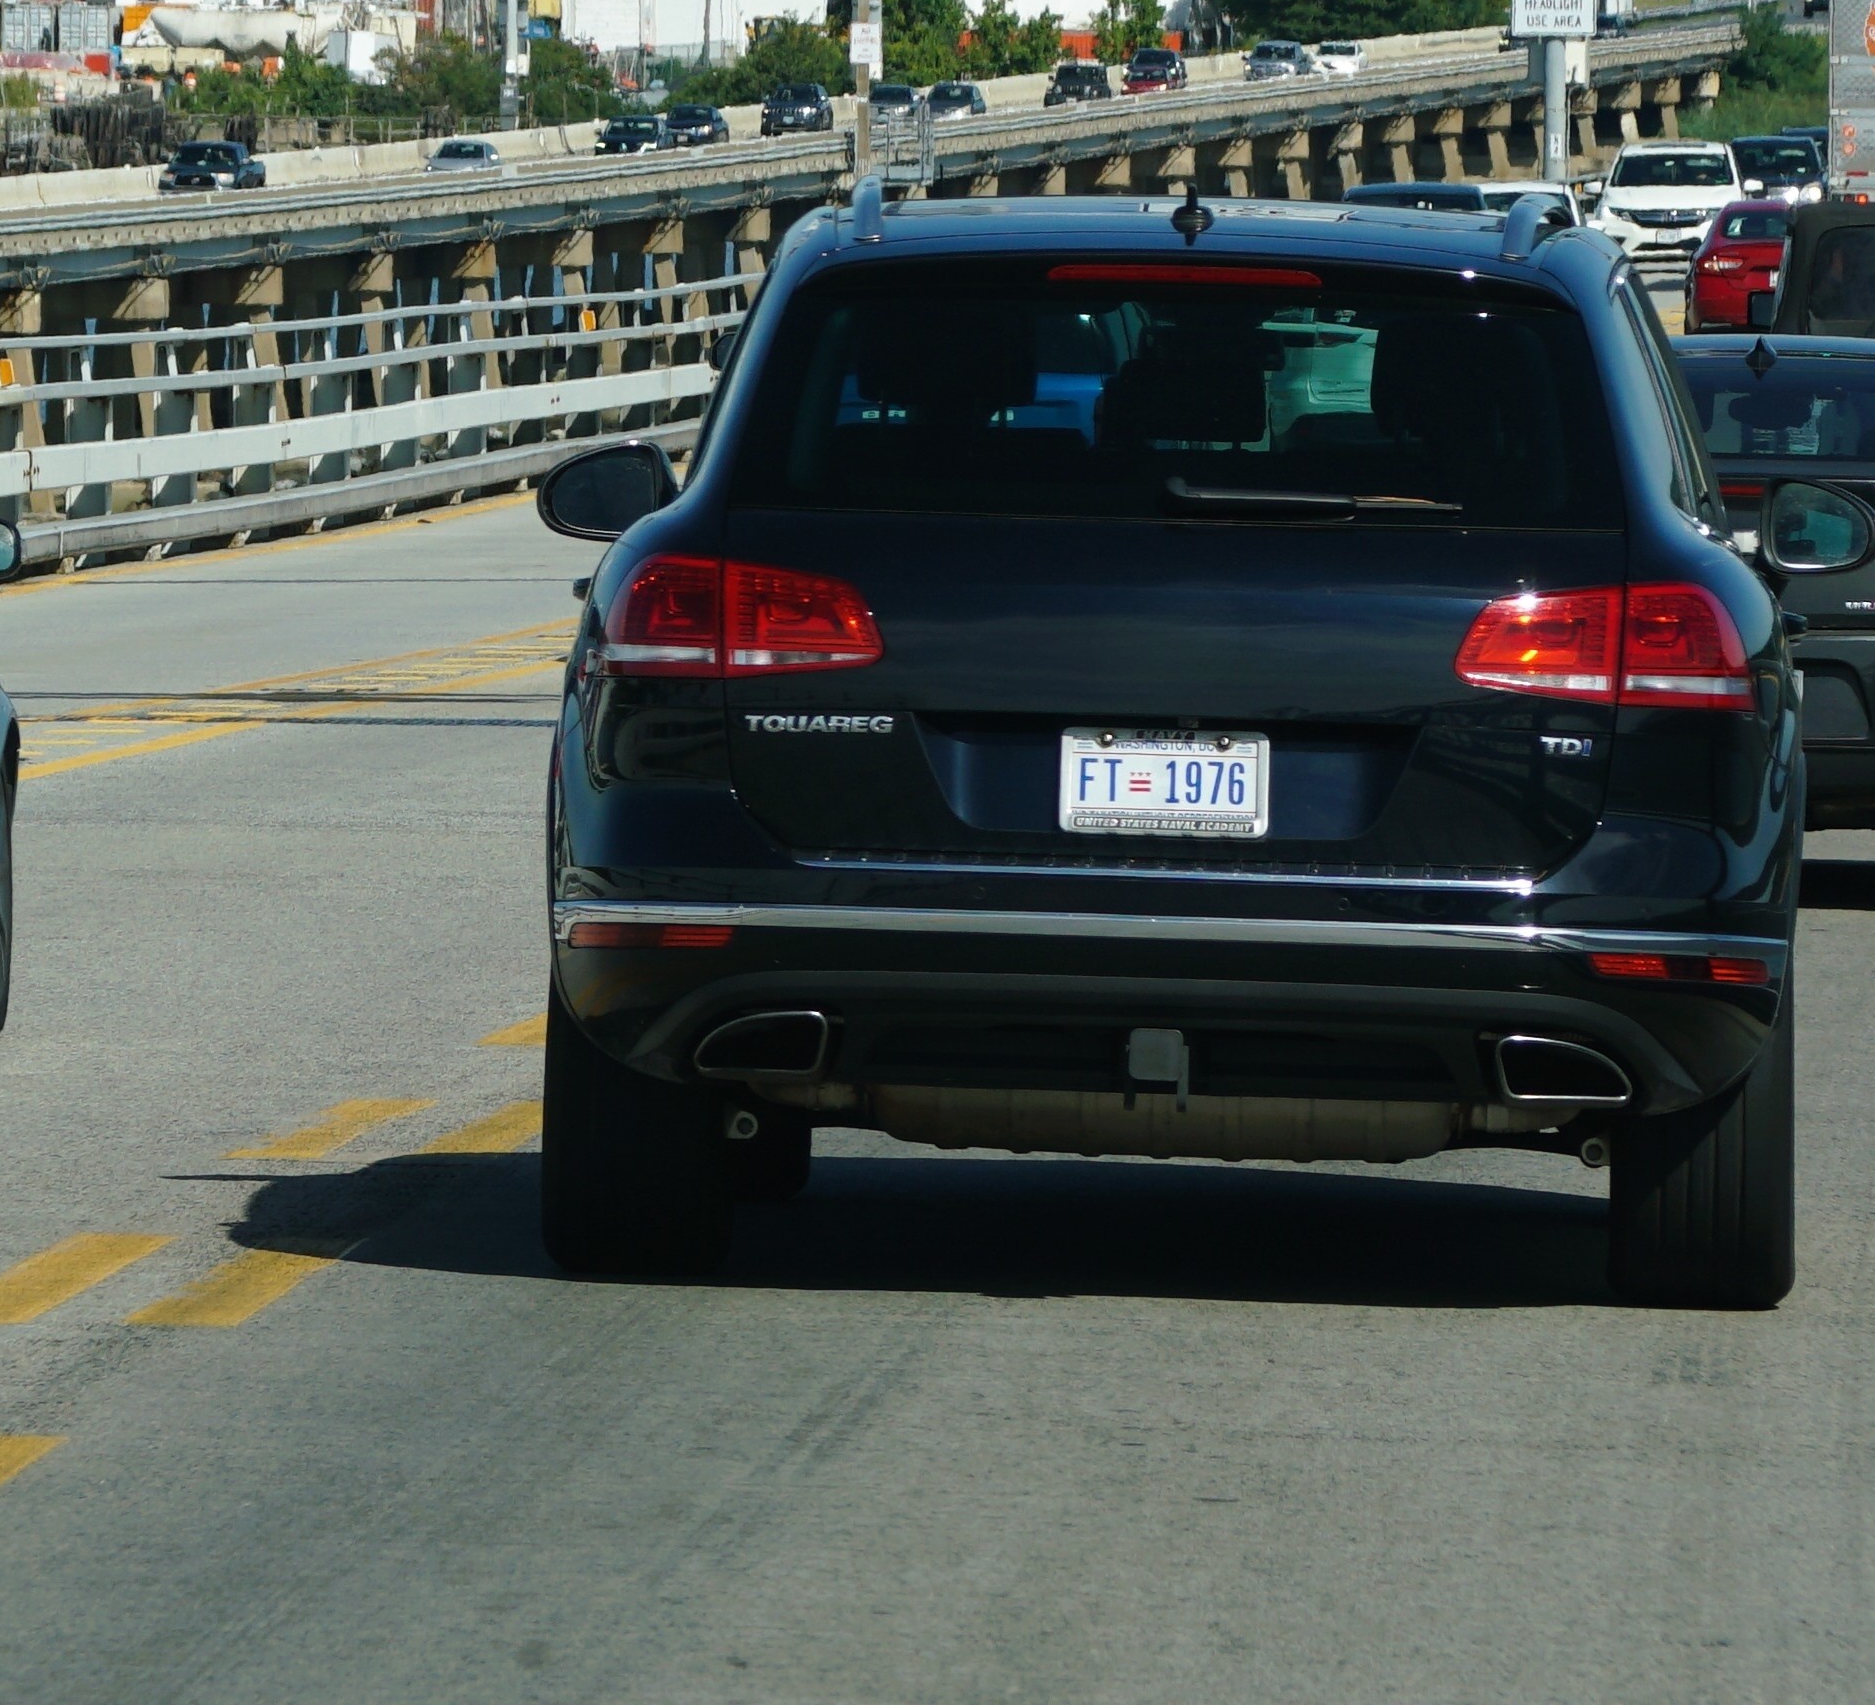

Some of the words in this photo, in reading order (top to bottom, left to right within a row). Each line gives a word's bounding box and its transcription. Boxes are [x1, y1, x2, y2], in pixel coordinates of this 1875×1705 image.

[1526, 15, 1548, 27] USE
[1553, 15, 1582, 27] AREA
[744, 714, 894, 734] TOUAREG
[1539, 735, 1594, 758] TDI
[1079, 757, 1123, 802] FT
[1165, 760, 1245, 805] 1976
[1076, 817, 1118, 827] UNITED
[1120, 818, 1159, 829] STATES
[1160, 820, 1197, 830] NAVAL
[1199, 821, 1252, 833] ACADEMY
